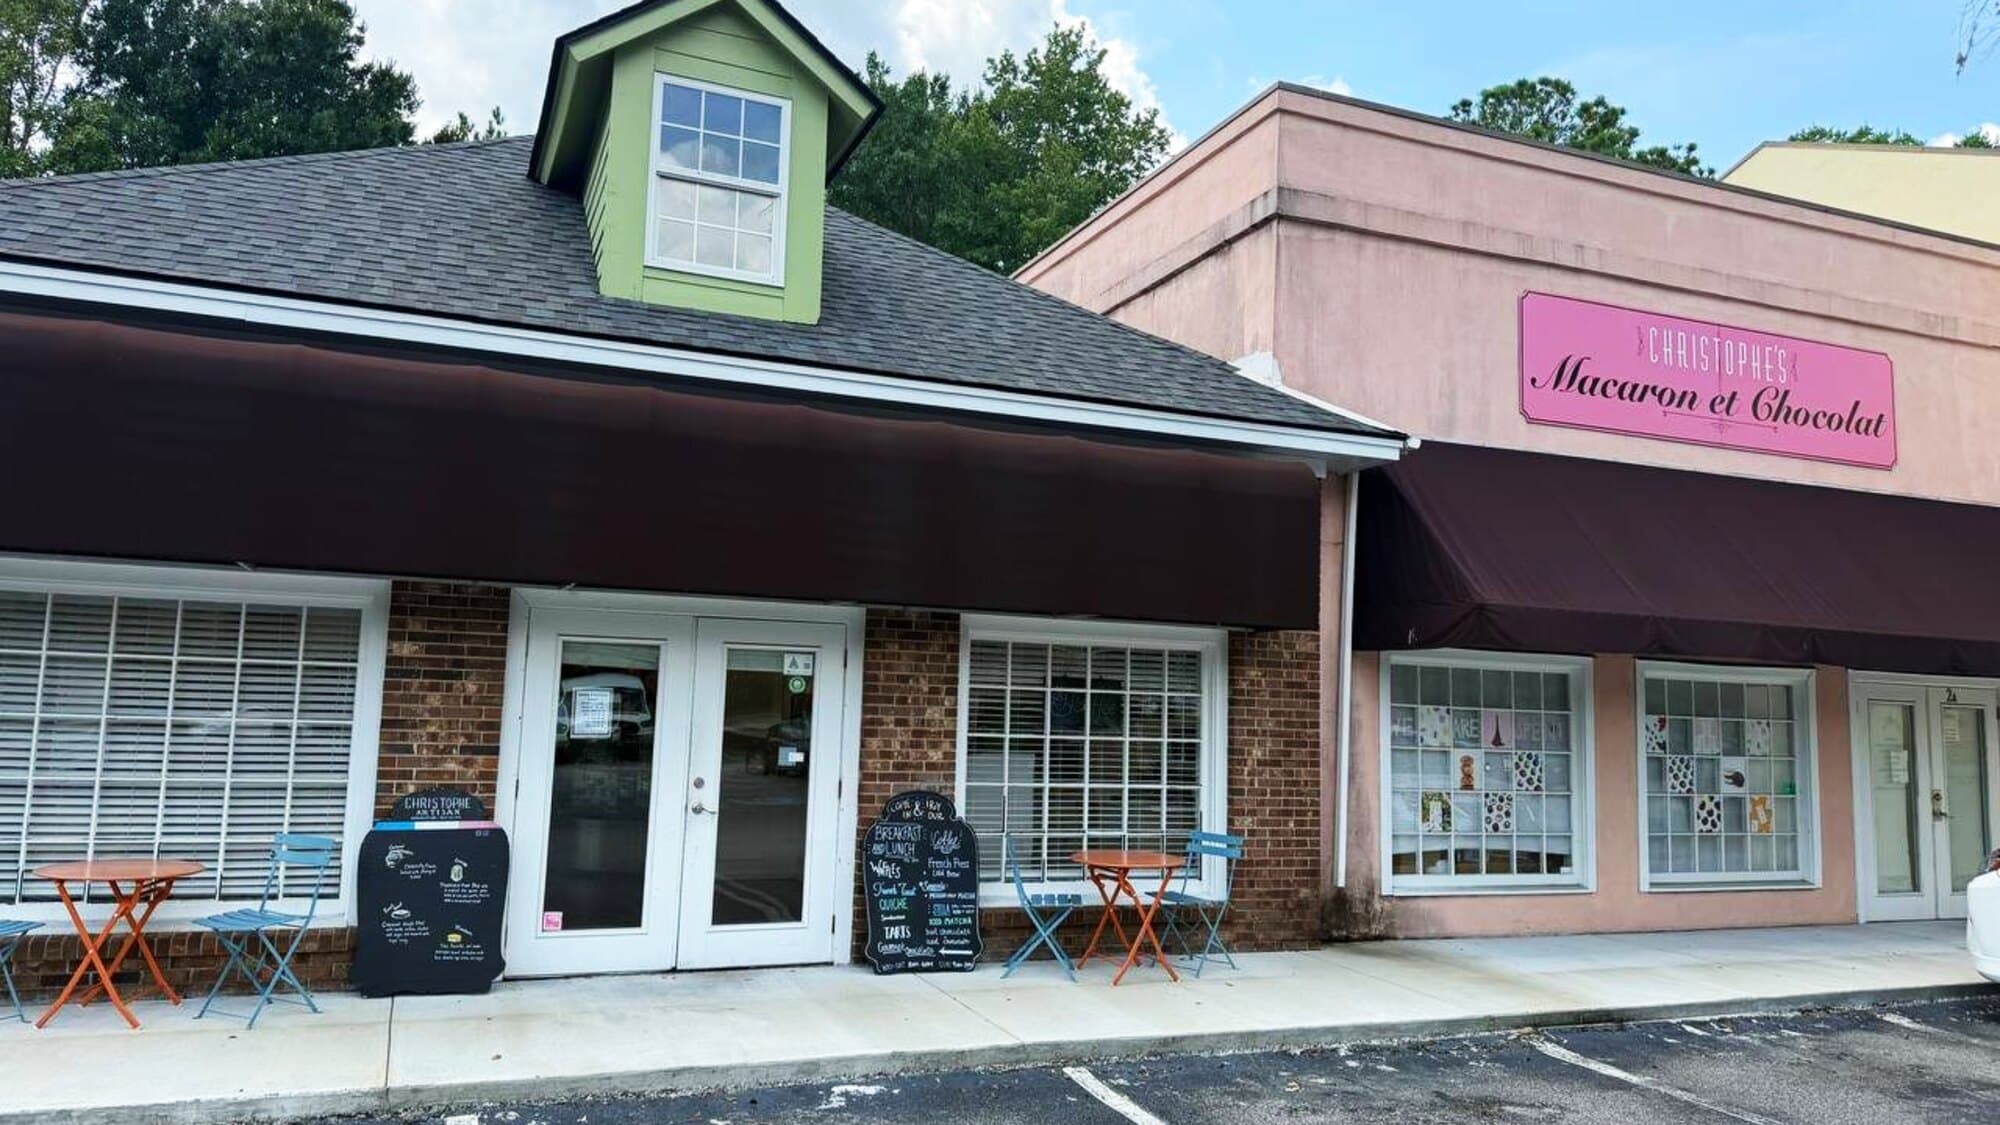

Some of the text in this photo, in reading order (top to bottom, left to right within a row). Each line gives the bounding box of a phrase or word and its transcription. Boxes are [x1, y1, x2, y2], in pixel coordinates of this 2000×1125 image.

[1649, 326, 1788, 384] CHRISTOPHE'S
[1530, 353, 1889, 439] Macaron et Chocolat
[404, 796, 472, 809] CHRISTOPHE
[874, 824, 923, 841] BREAKFAST
[885, 841, 916, 857] LUNCH
[883, 924, 912, 940] TARTS
